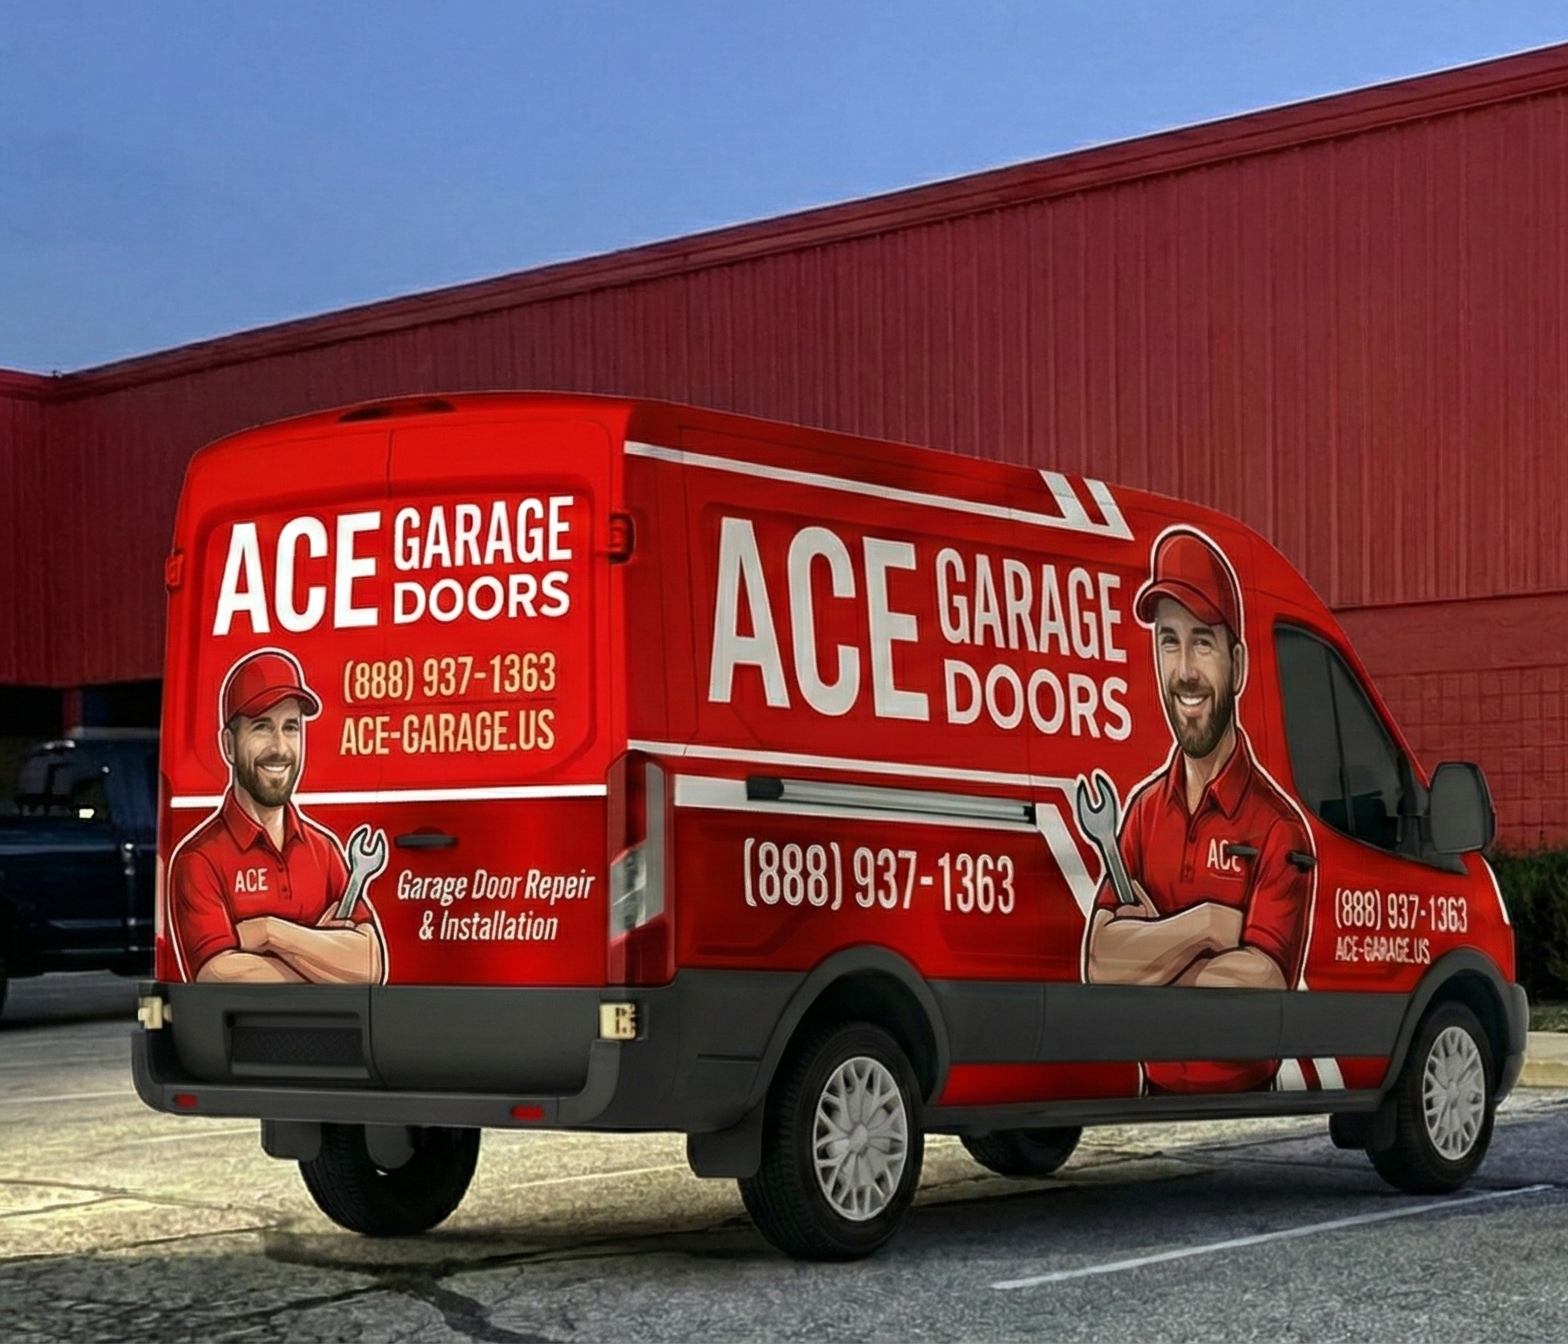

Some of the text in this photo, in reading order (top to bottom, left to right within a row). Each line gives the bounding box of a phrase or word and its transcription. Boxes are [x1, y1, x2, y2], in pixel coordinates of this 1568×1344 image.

[212, 495, 574, 636] ACE GARAGE
[393, 570, 570, 625] DOORS
[708, 516, 1127, 722] ACE GARAGE
[344, 651, 556, 703] (888) 937-1363
[943, 658, 1132, 741] DOORS
[340, 708, 555, 755] ACE-GARAGE.US
[234, 868, 269, 893] ACE
[397, 869, 468, 907] Garage
[471, 869, 523, 900] Door
[744, 837, 1015, 914] (888) 937-1363
[418, 909, 559, 941] & Installation
[1335, 887, 1468, 933] (888) 937-1363
